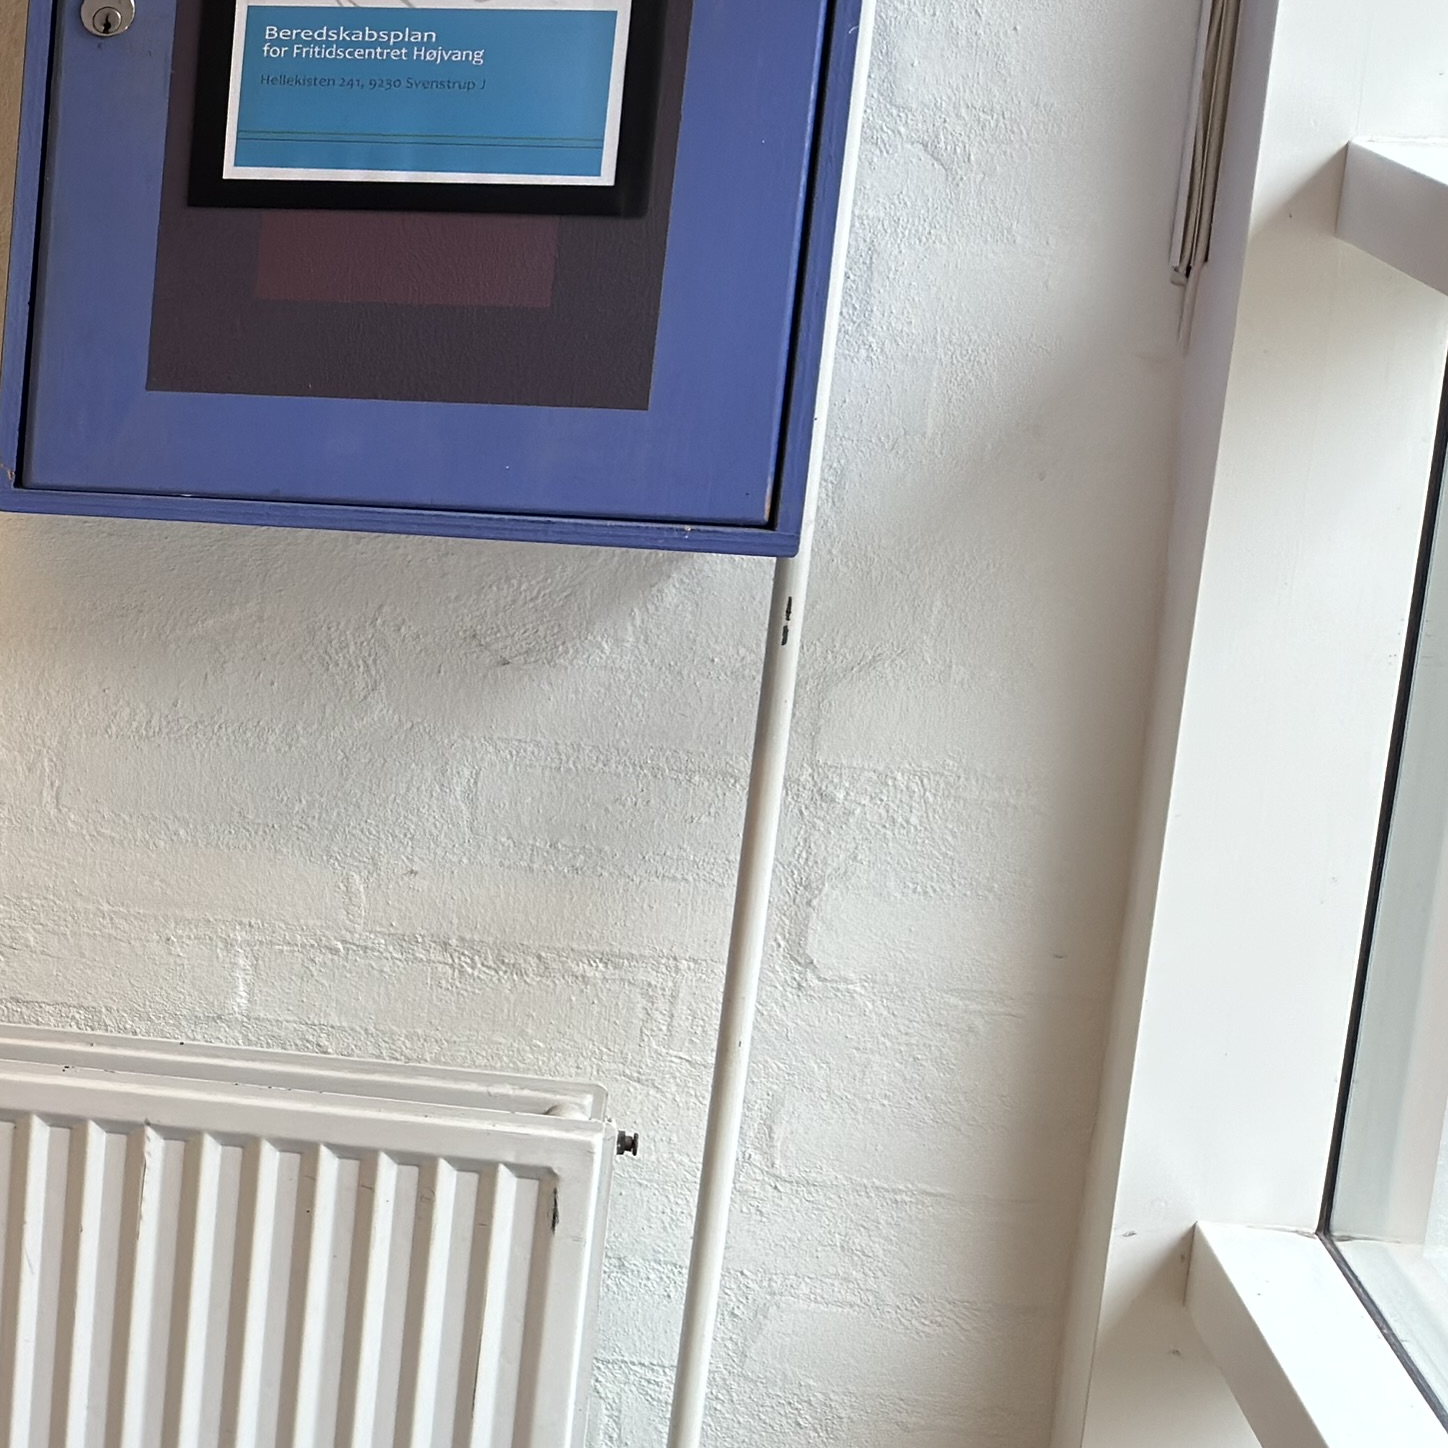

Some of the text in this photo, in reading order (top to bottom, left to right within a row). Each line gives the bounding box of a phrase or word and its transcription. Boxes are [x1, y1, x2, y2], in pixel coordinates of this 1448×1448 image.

[265, 26, 436, 44] Beredskabsplan
[263, 44, 485, 65] for Fritidscentret Højvang
[260, 75, 486, 91] Hellekisten 241, 9230 Svenstrup J
